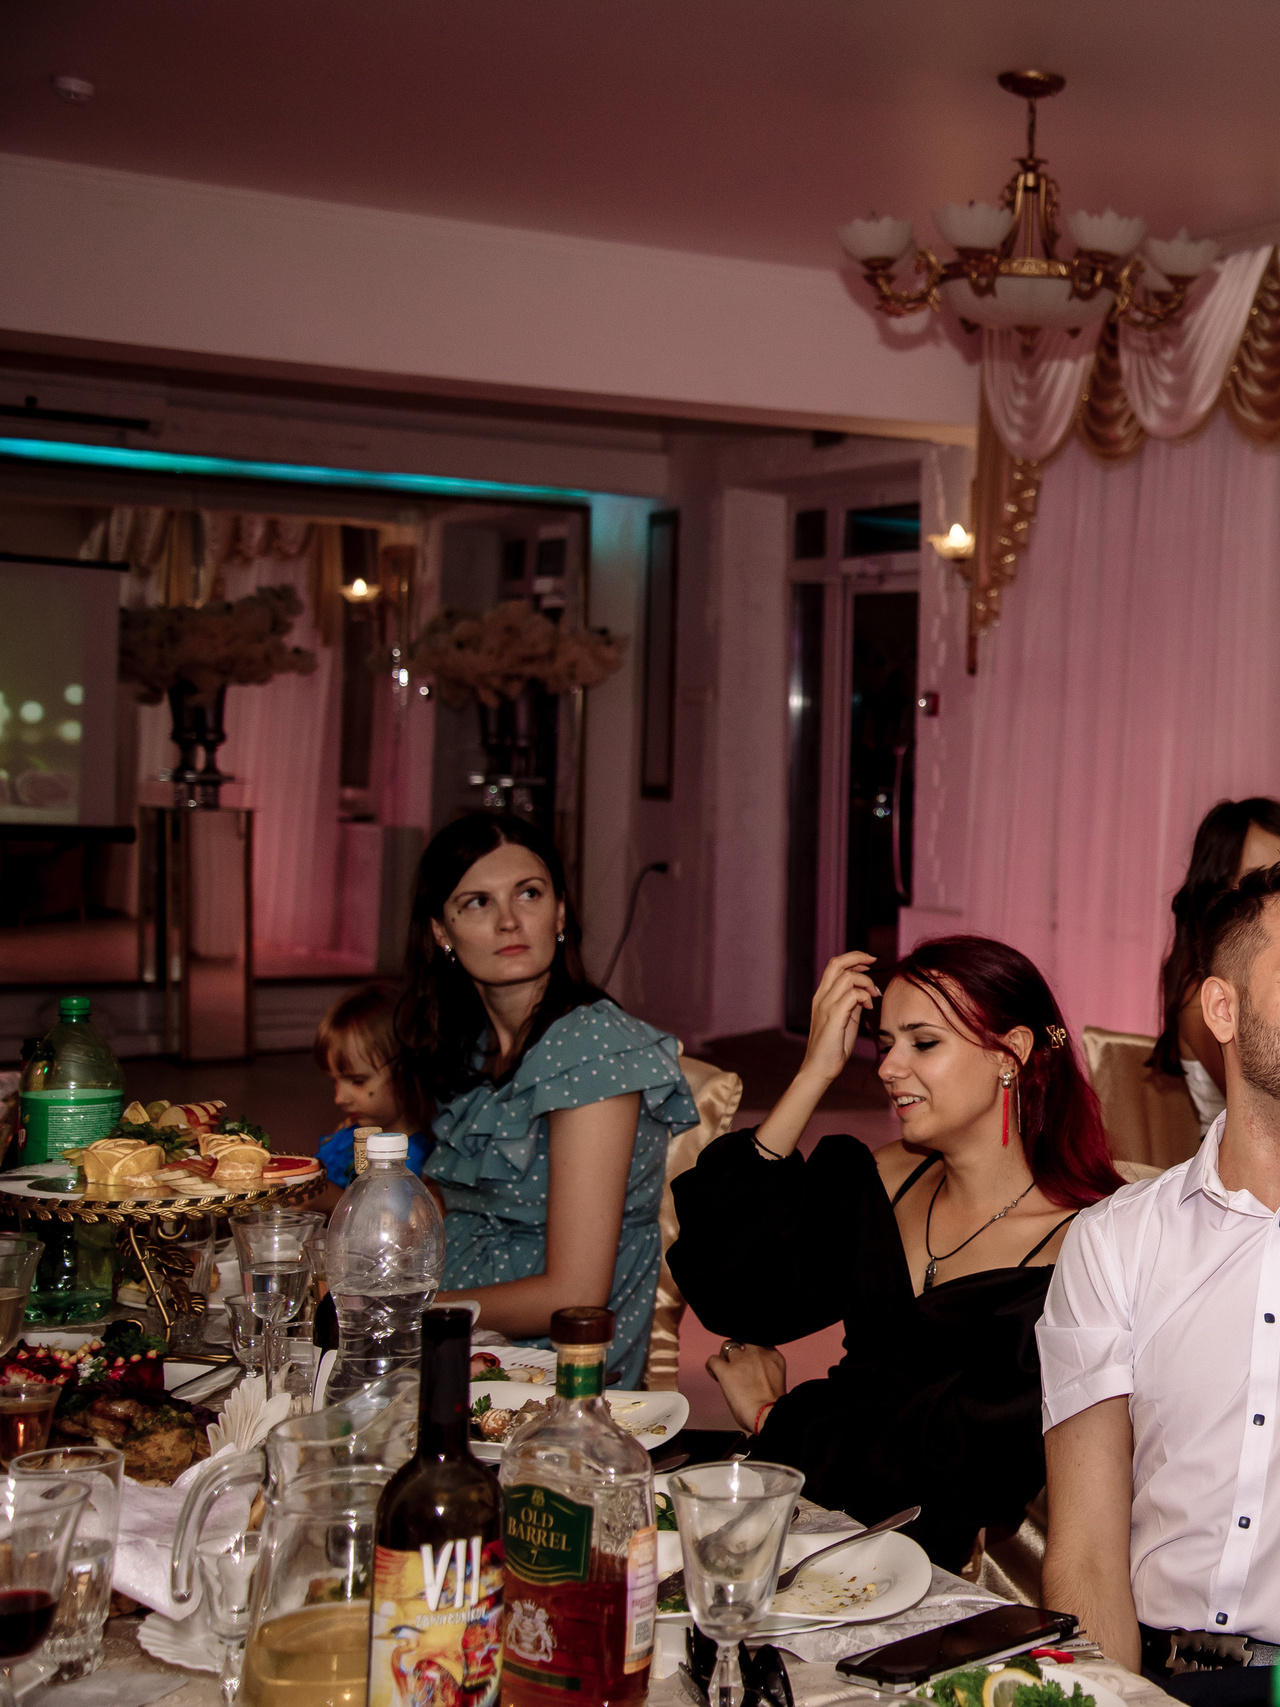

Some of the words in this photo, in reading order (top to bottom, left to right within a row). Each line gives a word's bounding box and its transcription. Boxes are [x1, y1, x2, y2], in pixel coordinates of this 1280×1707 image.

[521, 1506, 554, 1529] OLD
[507, 1515, 572, 1552] BARREL
[530, 1549, 538, 1565] 7
[420, 1535, 482, 1612] VII
